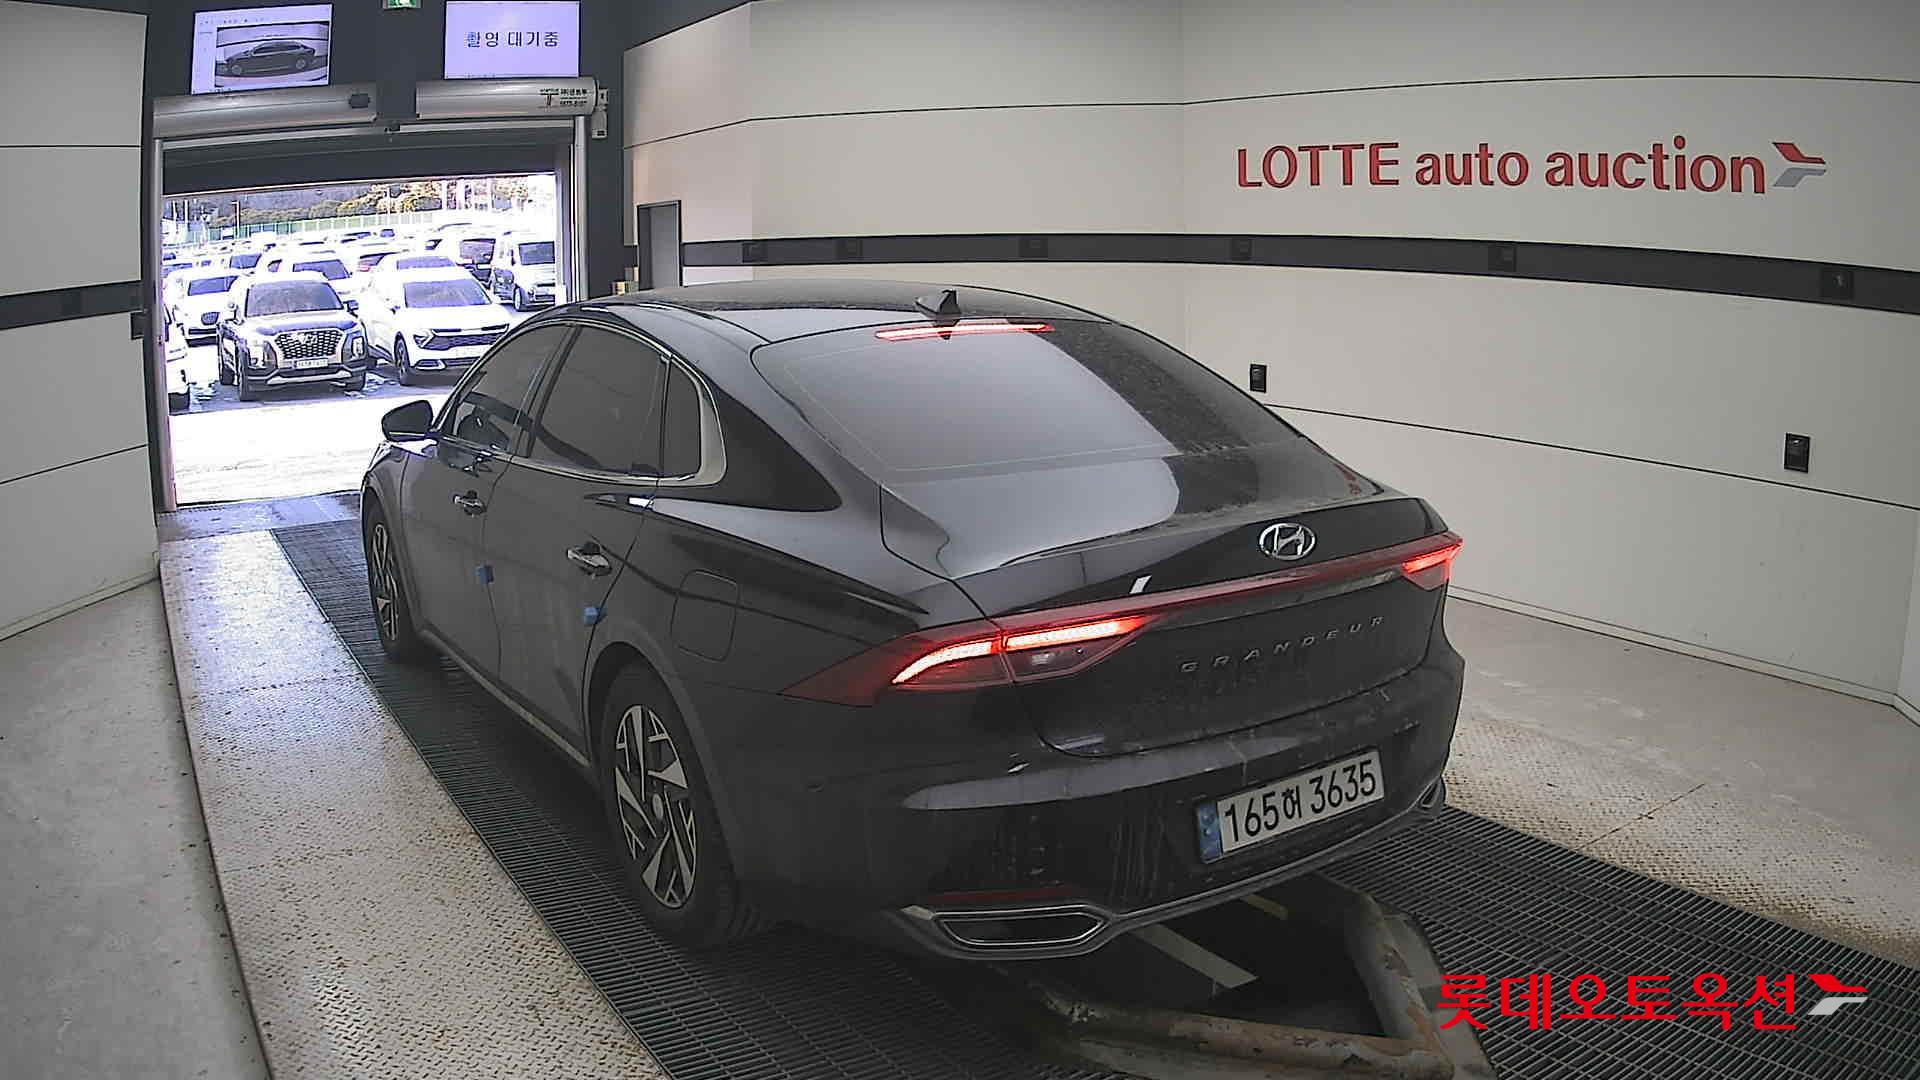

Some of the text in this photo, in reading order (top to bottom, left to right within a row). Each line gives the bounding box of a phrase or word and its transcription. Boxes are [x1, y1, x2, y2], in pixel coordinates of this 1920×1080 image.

[507, 31, 558, 48] 대기중
[1238, 135, 1765, 194] LOTTE auto auction
[1180, 615, 1384, 673] GRANDEUR
[1308, 759, 1377, 815] 3635
